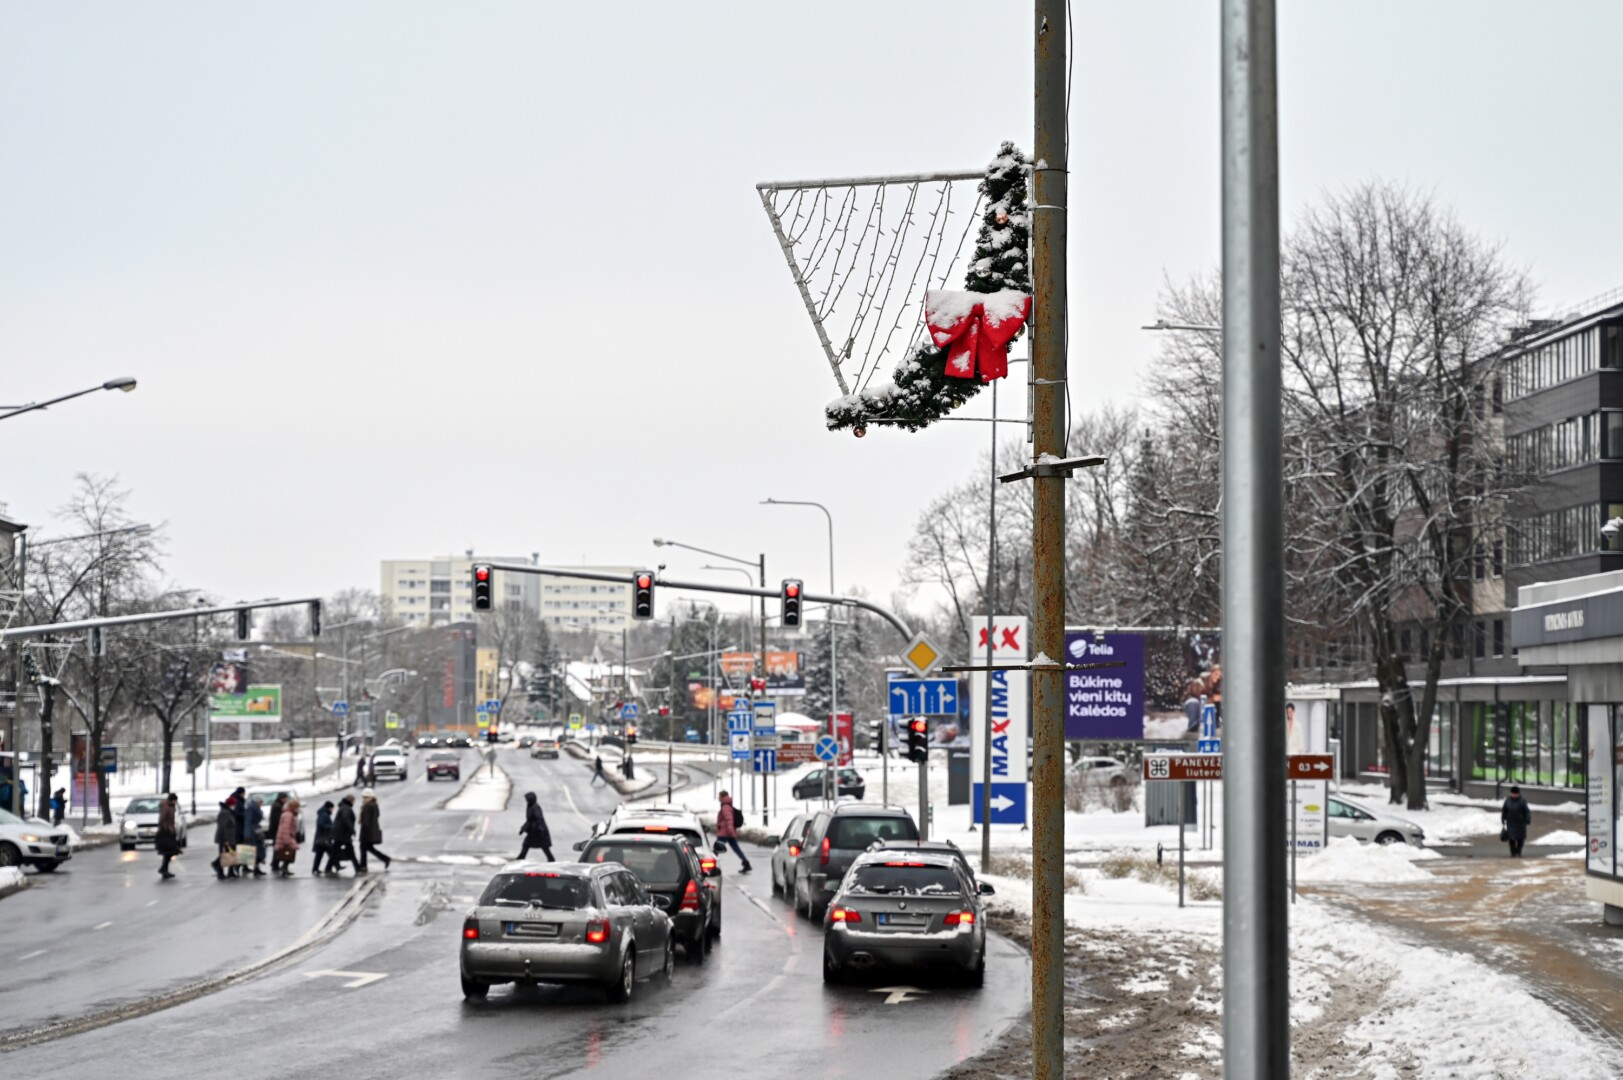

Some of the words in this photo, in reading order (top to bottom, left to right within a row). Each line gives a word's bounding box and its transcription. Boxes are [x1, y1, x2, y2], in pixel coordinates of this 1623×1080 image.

[1088, 643, 1114, 656] Telia
[1069, 675, 1123, 689] Būkime
[1069, 689, 1103, 702] vieni
[1104, 689, 1132, 706] kitų
[1069, 704, 1127, 717] Kalėdos
[991, 669, 1011, 776] MAXIMA
[1174, 755, 1222, 768] PANEVĖŽ
[1186, 768, 1224, 777] liutero
